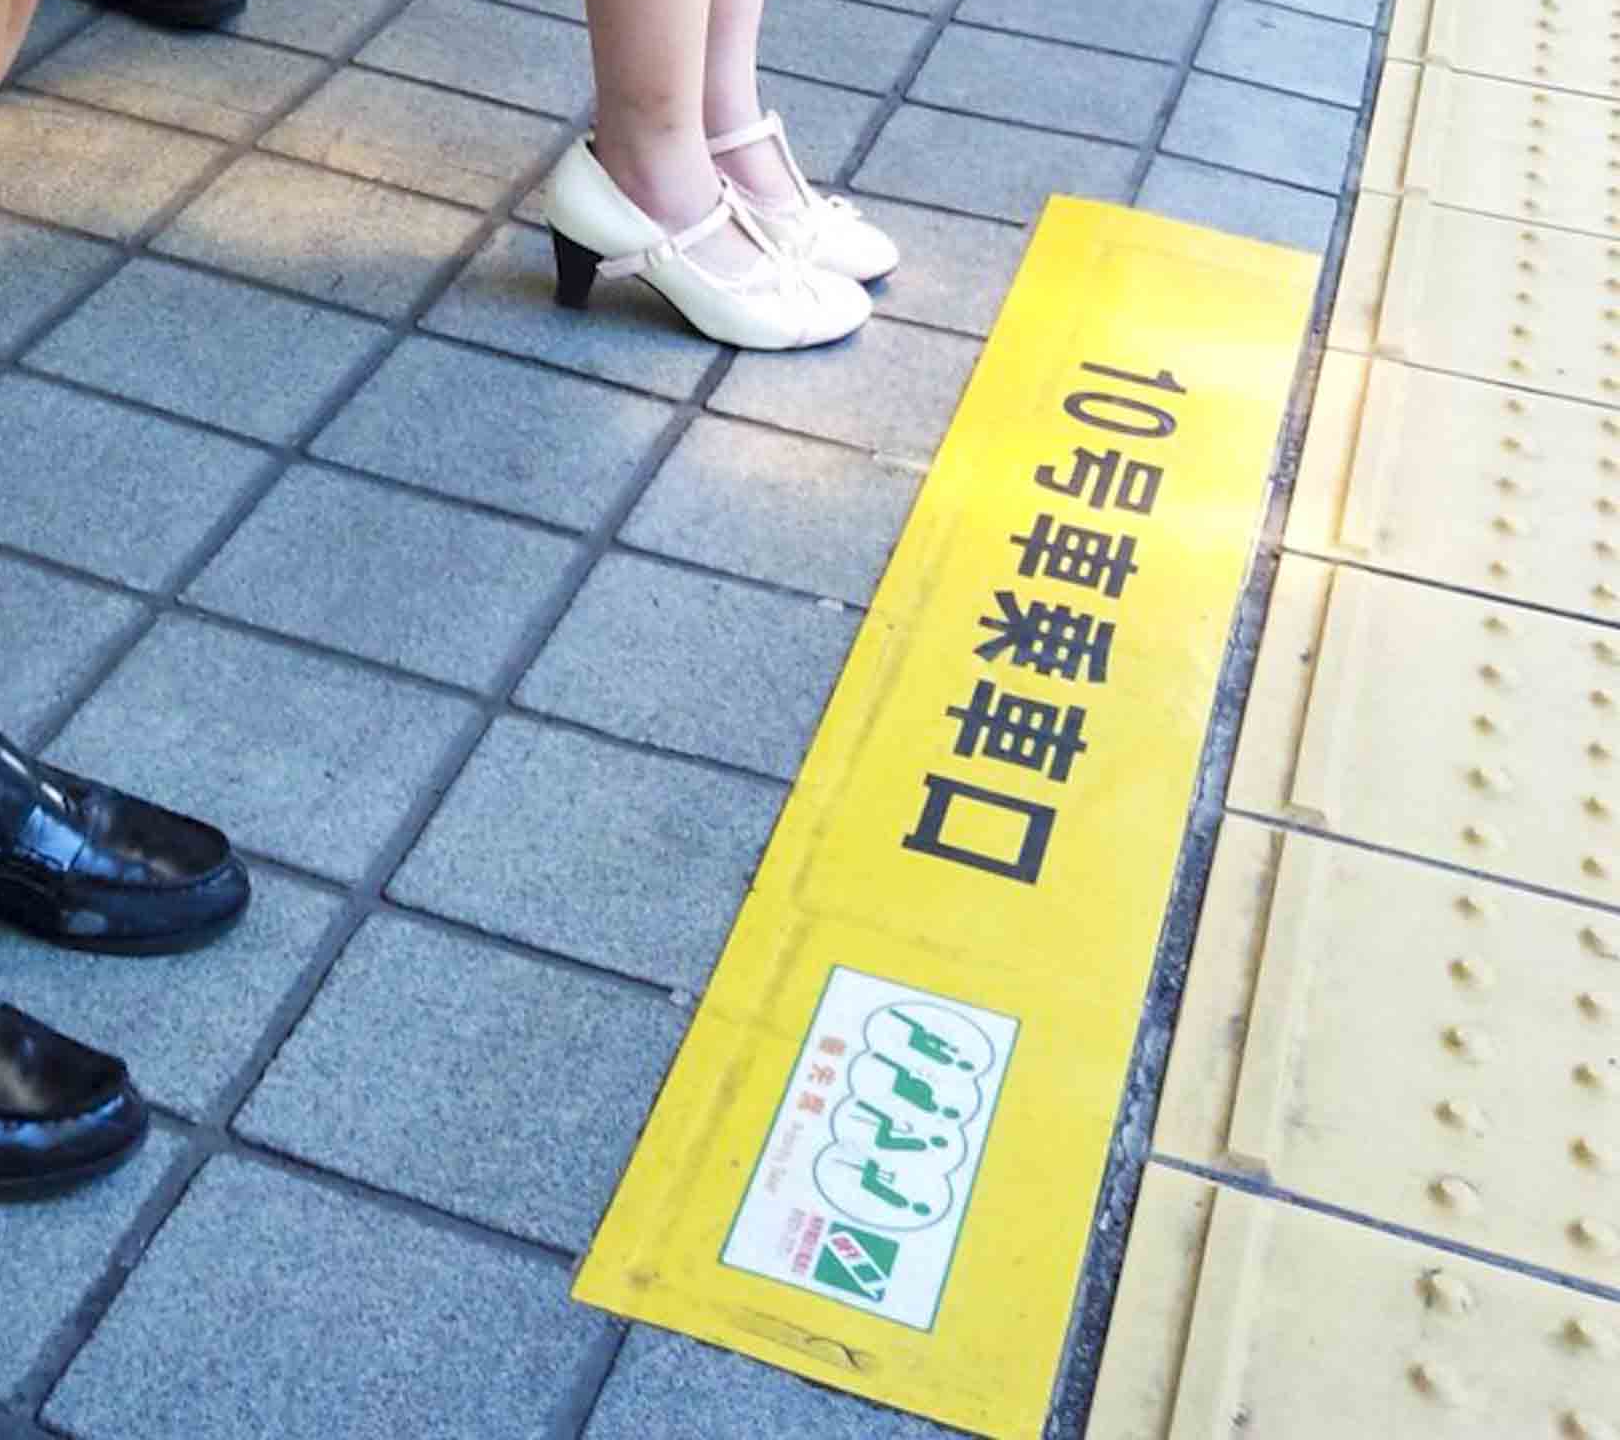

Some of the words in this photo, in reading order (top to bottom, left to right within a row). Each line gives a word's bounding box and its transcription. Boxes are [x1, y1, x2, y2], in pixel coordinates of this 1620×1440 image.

[902, 361, 1187, 886] 10号車乗車口
